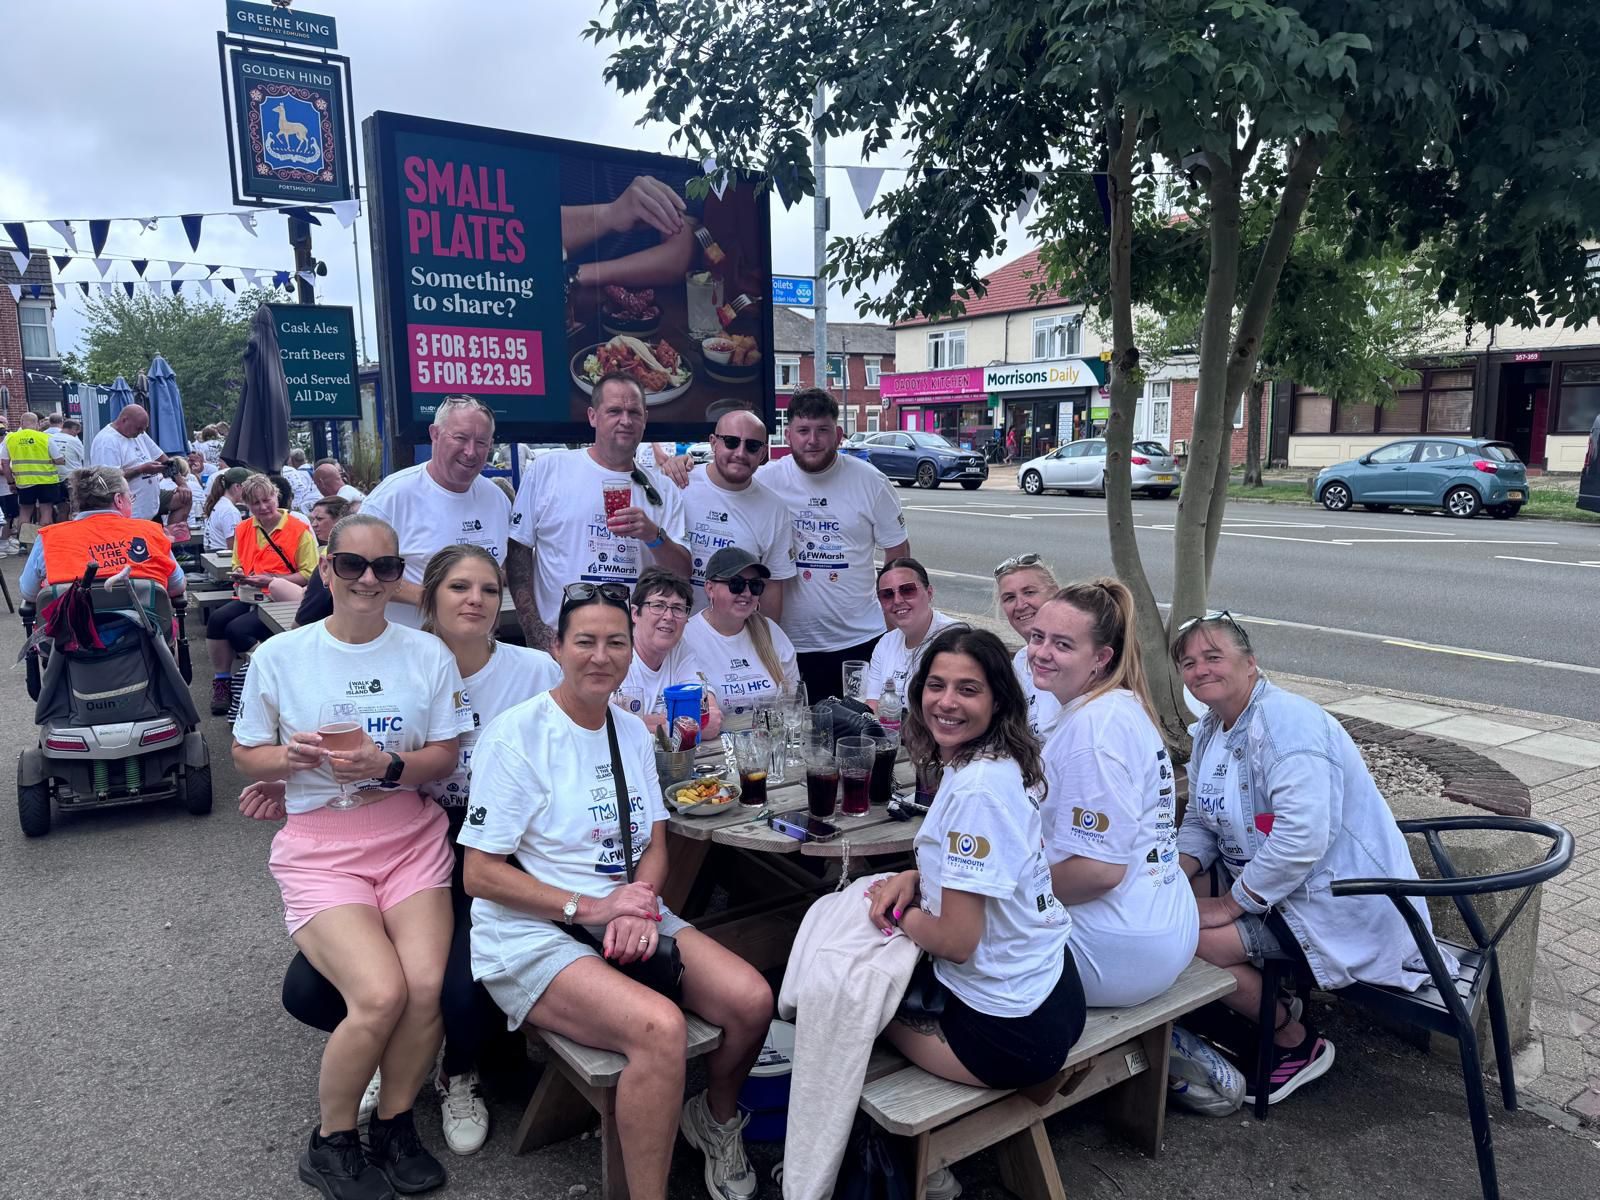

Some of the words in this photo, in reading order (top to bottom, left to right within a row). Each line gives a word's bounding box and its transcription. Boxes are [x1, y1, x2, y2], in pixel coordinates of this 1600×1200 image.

[236, 10, 291, 30] GREENE
[295, 20, 329, 36] KING
[242, 63, 296, 81] GOLDEN
[299, 71, 332, 86] HIND
[278, 184, 316, 193] PORTSMOUTH
[404, 156, 514, 214] SMALL
[408, 208, 526, 264] PLATES
[411, 266, 534, 299] Something
[772, 279, 793, 290] oilets
[413, 292, 437, 312] to
[442, 293, 517, 319] share?
[281, 322, 311, 333] Cask
[313, 323, 338, 334] Ales
[416, 333, 428, 356] 3
[431, 334, 465, 358] FOR
[468, 336, 527, 360] £15.95
[280, 348, 310, 360] Craft
[312, 350, 345, 360] Beers
[285, 373, 308, 385] ood
[310, 374, 351, 385] Served
[418, 361, 431, 384] 5
[433, 362, 467, 385] FOR
[470, 364, 532, 387] £23.95
[987, 369, 1047, 386] Morrisons
[1049, 366, 1079, 385] Daily
[931, 374, 970, 389] KITCHEN
[98, 394, 109, 404] UP
[294, 390, 312, 402] All
[314, 391, 338, 404] Day
[819, 522, 839, 531] HFC
[94, 541, 126, 553] WALK
[101, 549, 122, 559] THE
[807, 552, 845, 560] FWMarsh
[598, 564, 637, 574] FWMarsh
[747, 680, 771, 692] HFC
[367, 716, 403, 733] HFC
[588, 802, 618, 822] TMJ
[1071, 827, 1105, 840] PORTSMOUTH
[947, 855, 985, 868] PORTSMOUTH
